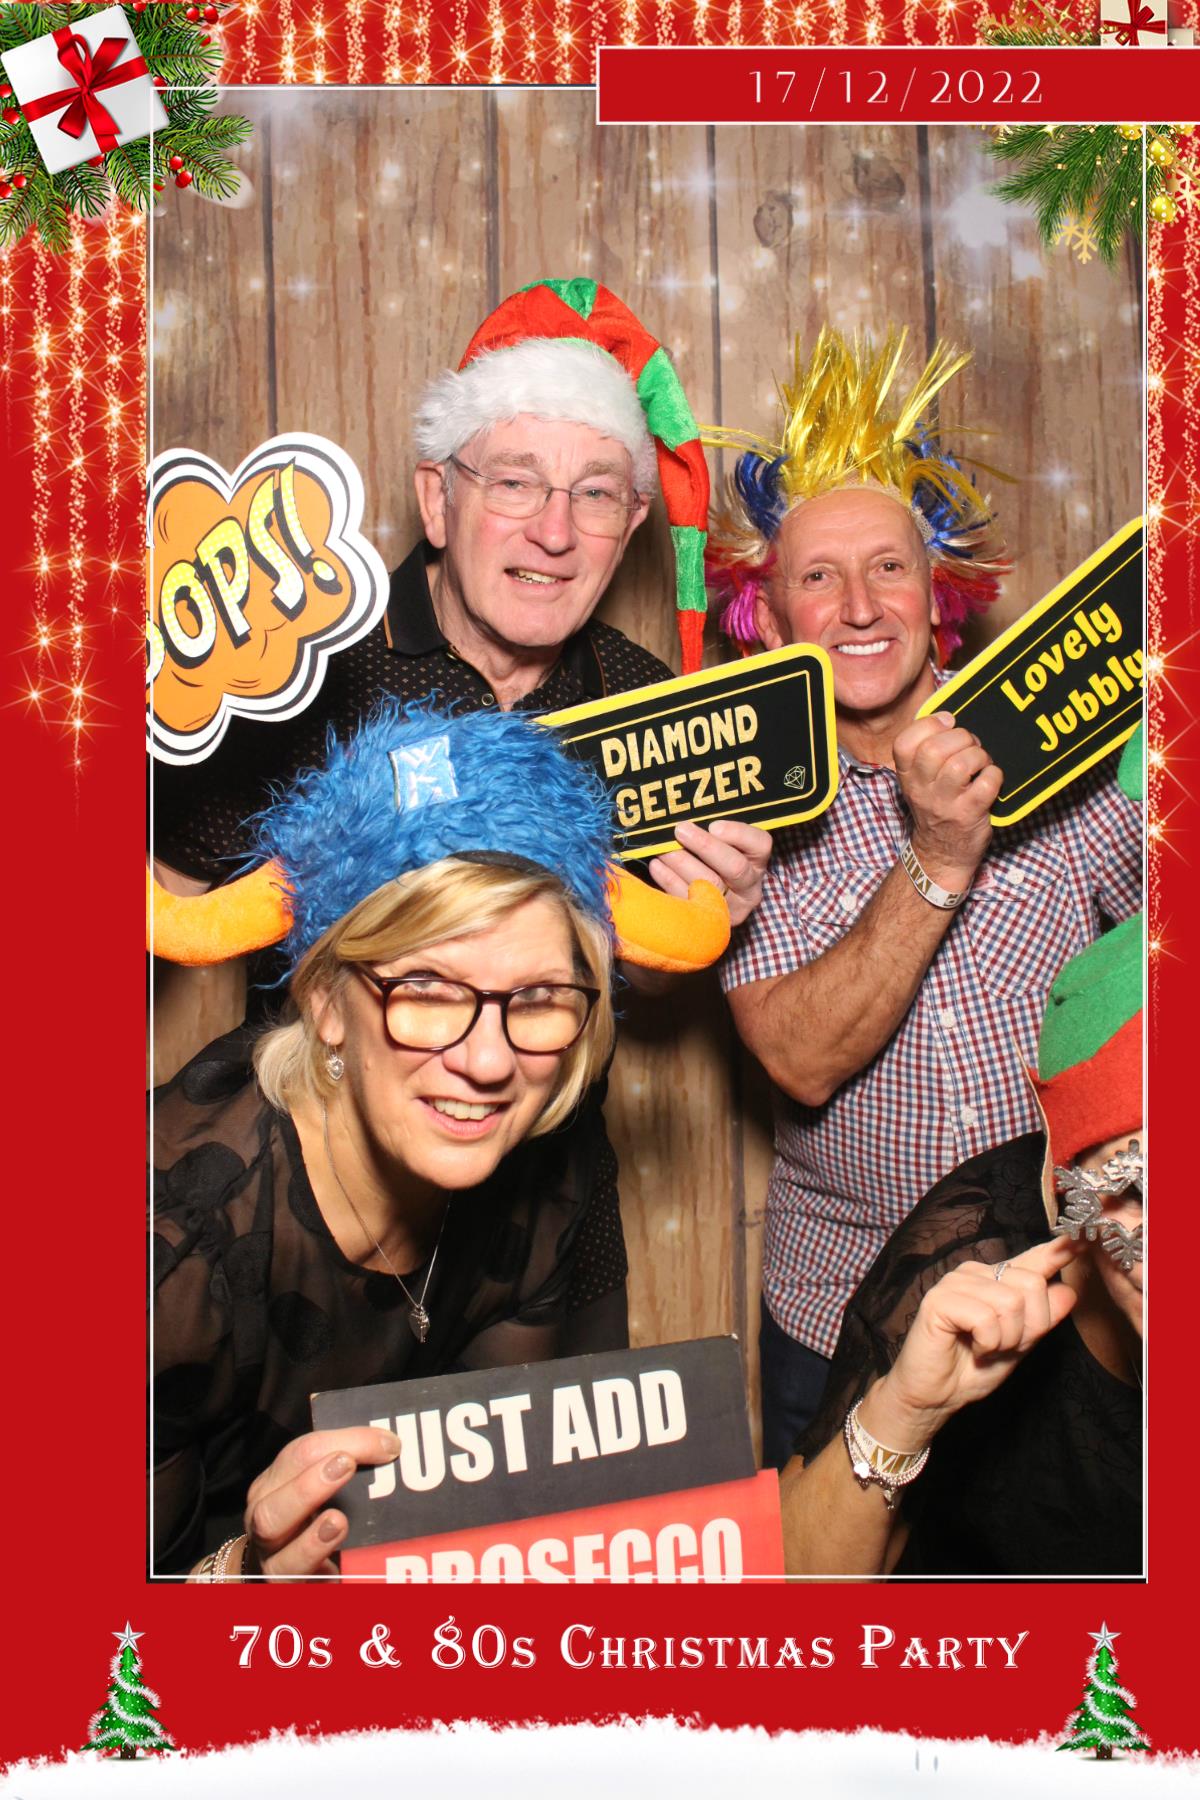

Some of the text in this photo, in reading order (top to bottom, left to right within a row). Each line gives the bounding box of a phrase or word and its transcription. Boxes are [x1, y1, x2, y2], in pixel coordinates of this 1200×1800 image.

[1001, 603, 1123, 712] Lovely
[600, 704, 758, 778] DIAMOND
[615, 756, 765, 828] GEEZER
[552, 1369, 687, 1465] ADD
